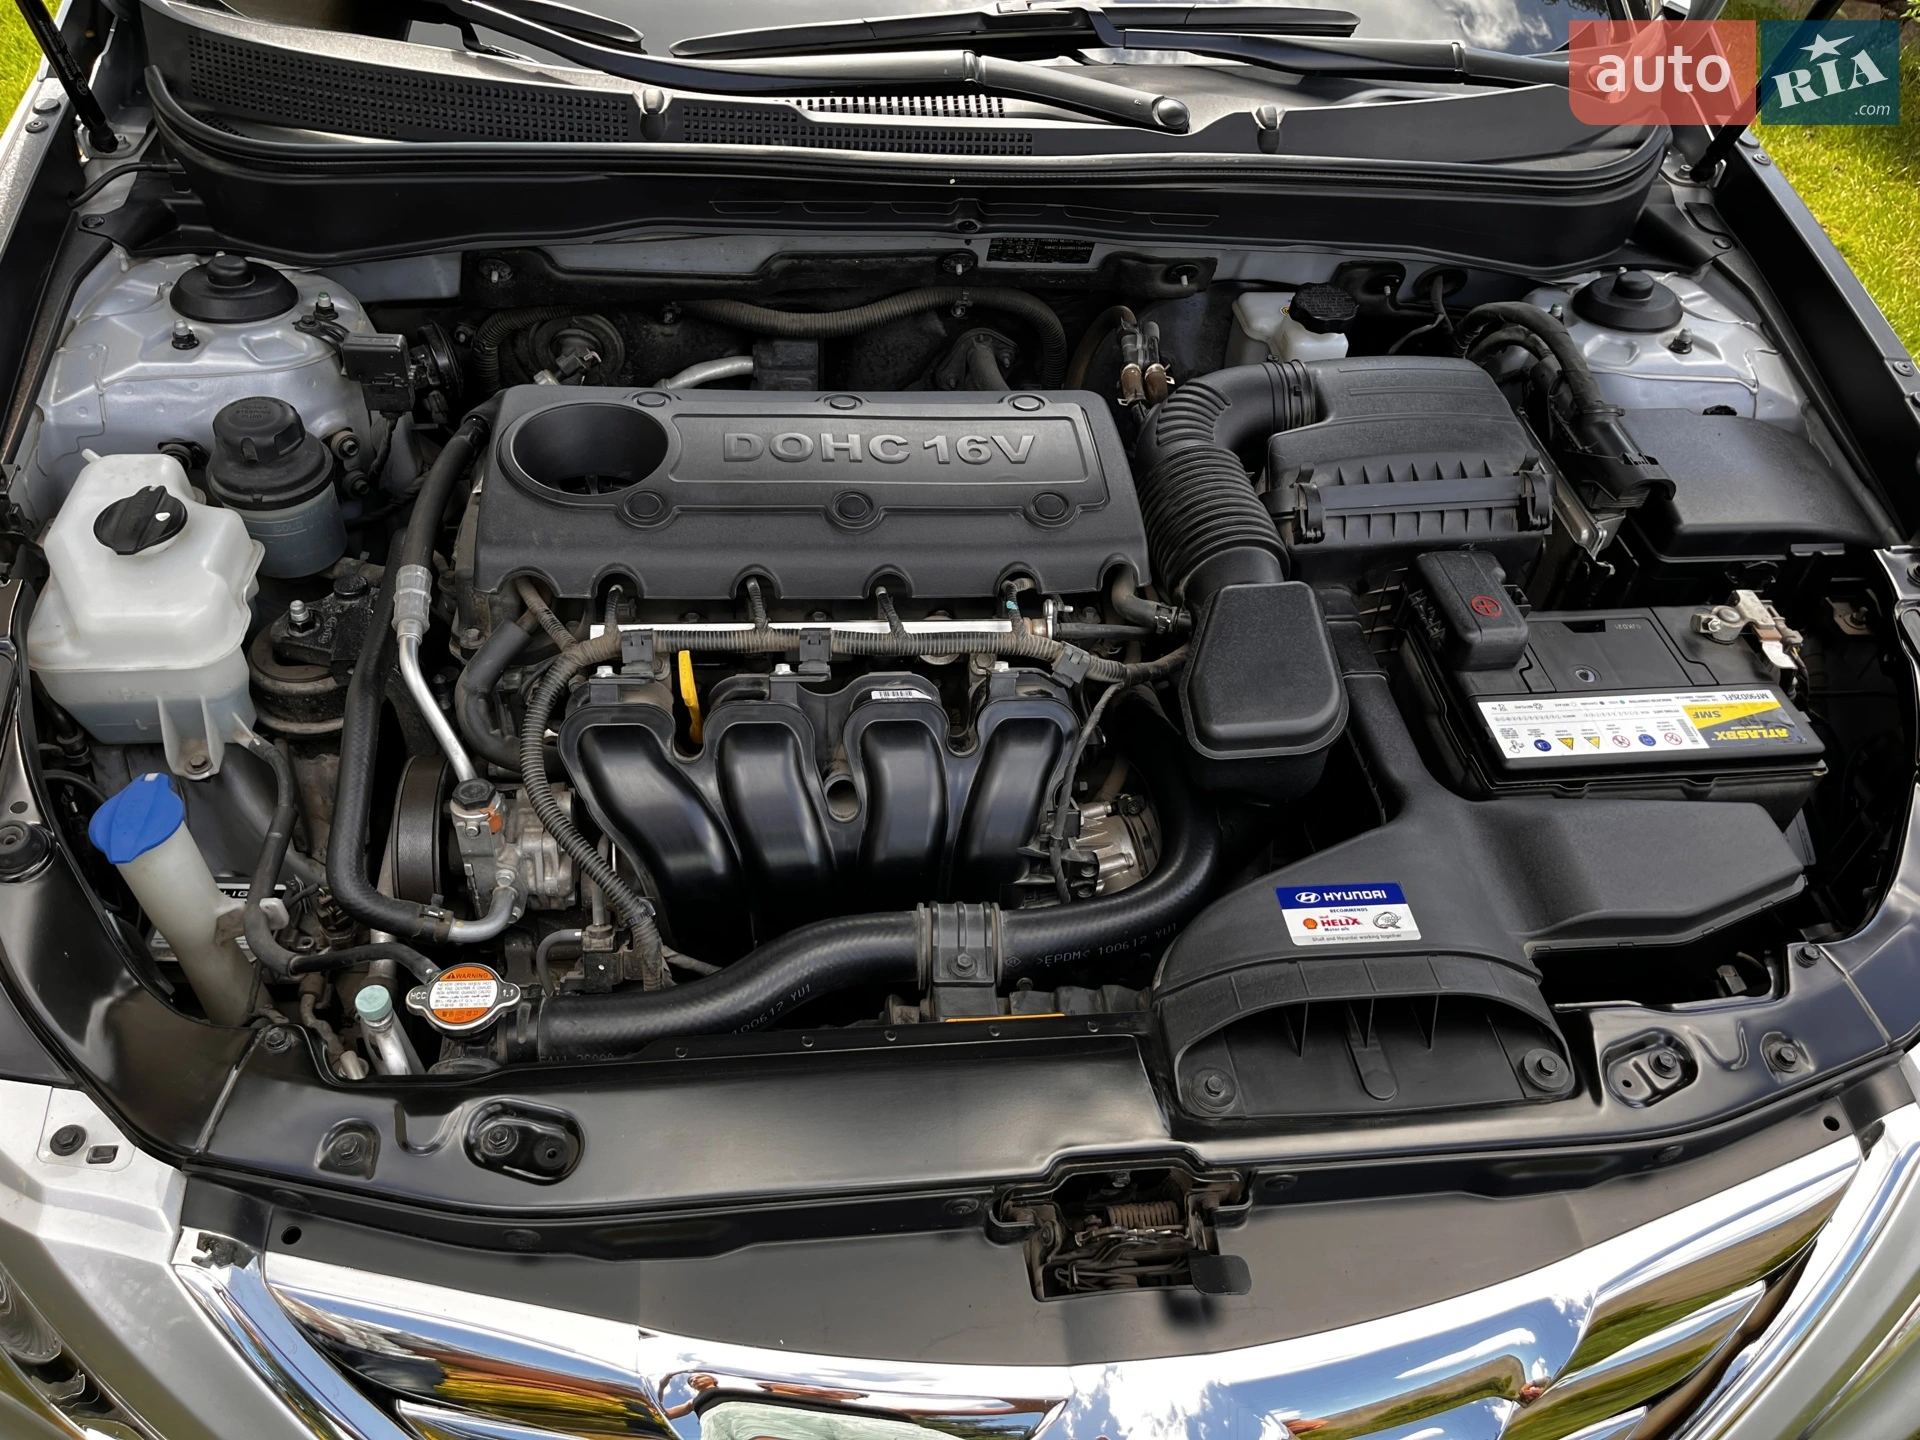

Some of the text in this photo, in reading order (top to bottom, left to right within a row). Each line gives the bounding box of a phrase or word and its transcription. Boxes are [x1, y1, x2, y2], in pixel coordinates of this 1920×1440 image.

[723, 433, 1035, 465] DOHC 16V
[1692, 710, 1722, 719] SMF
[1713, 728, 1789, 741] ATLASBX
[1323, 889, 1387, 901] HYUNDAI
[1320, 918, 1361, 927] HELIX
[410, 991, 427, 1000] HCC
[502, 989, 514, 997] 1.1
